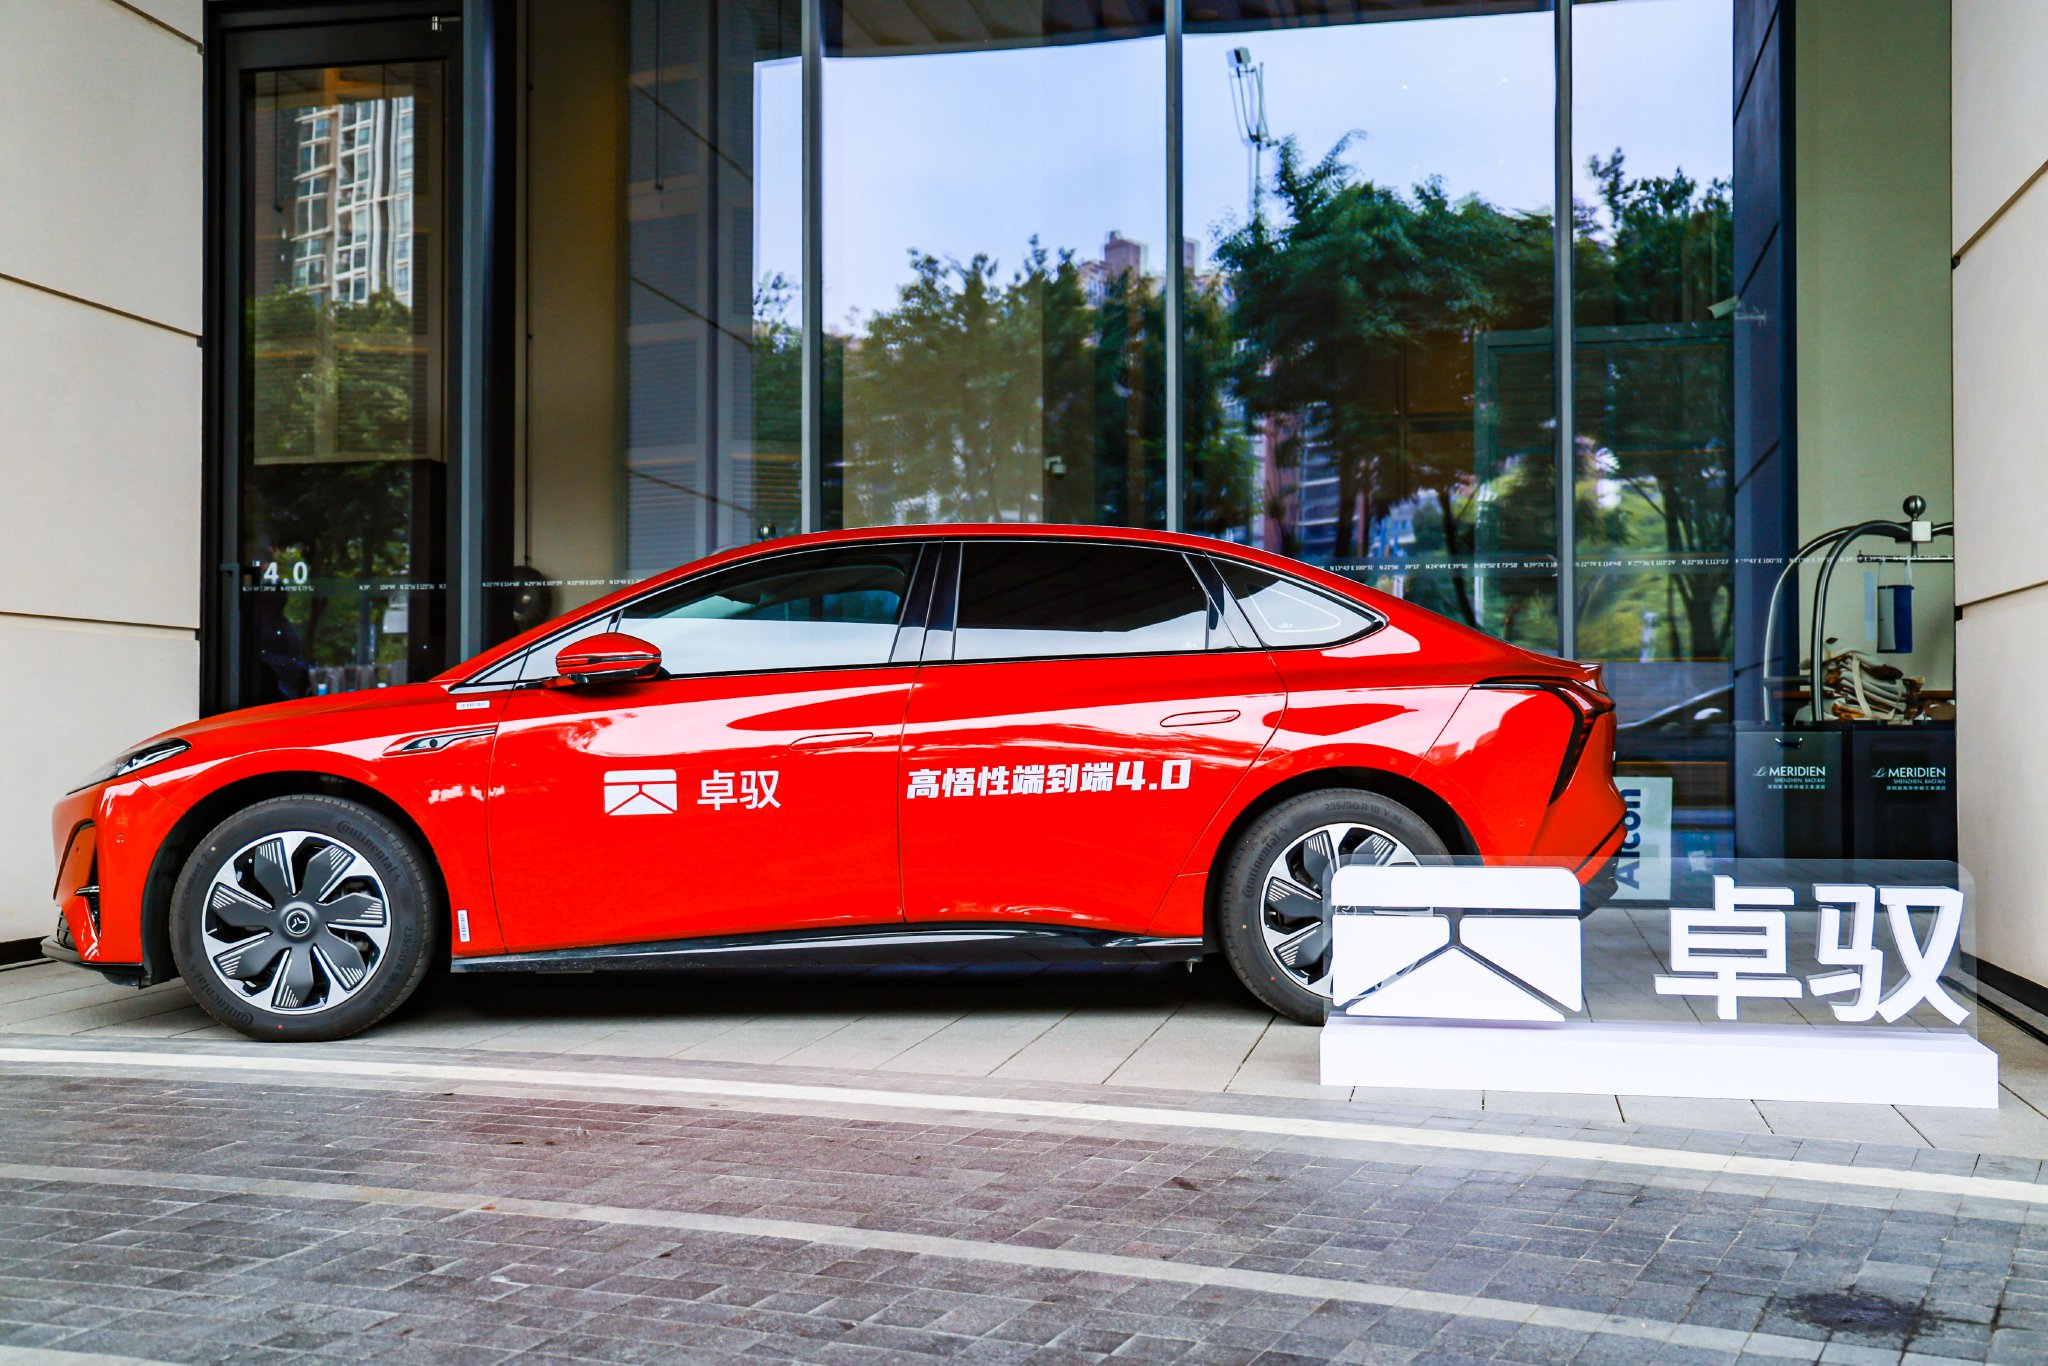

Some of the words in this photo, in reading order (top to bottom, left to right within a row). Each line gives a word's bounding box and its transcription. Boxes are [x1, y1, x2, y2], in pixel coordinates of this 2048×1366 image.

[697, 769, 781, 811] 卓驭
[906, 759, 1192, 799] 高悟性端到端4.0
[1769, 766, 1826, 777] MERIDIEN
[1888, 767, 1946, 778] MERIDIEN
[336, 820, 398, 874] Continental
[1615, 788, 1642, 890] Alcon
[1243, 832, 1281, 898] Continental
[1653, 874, 1971, 1026] 卓驭
